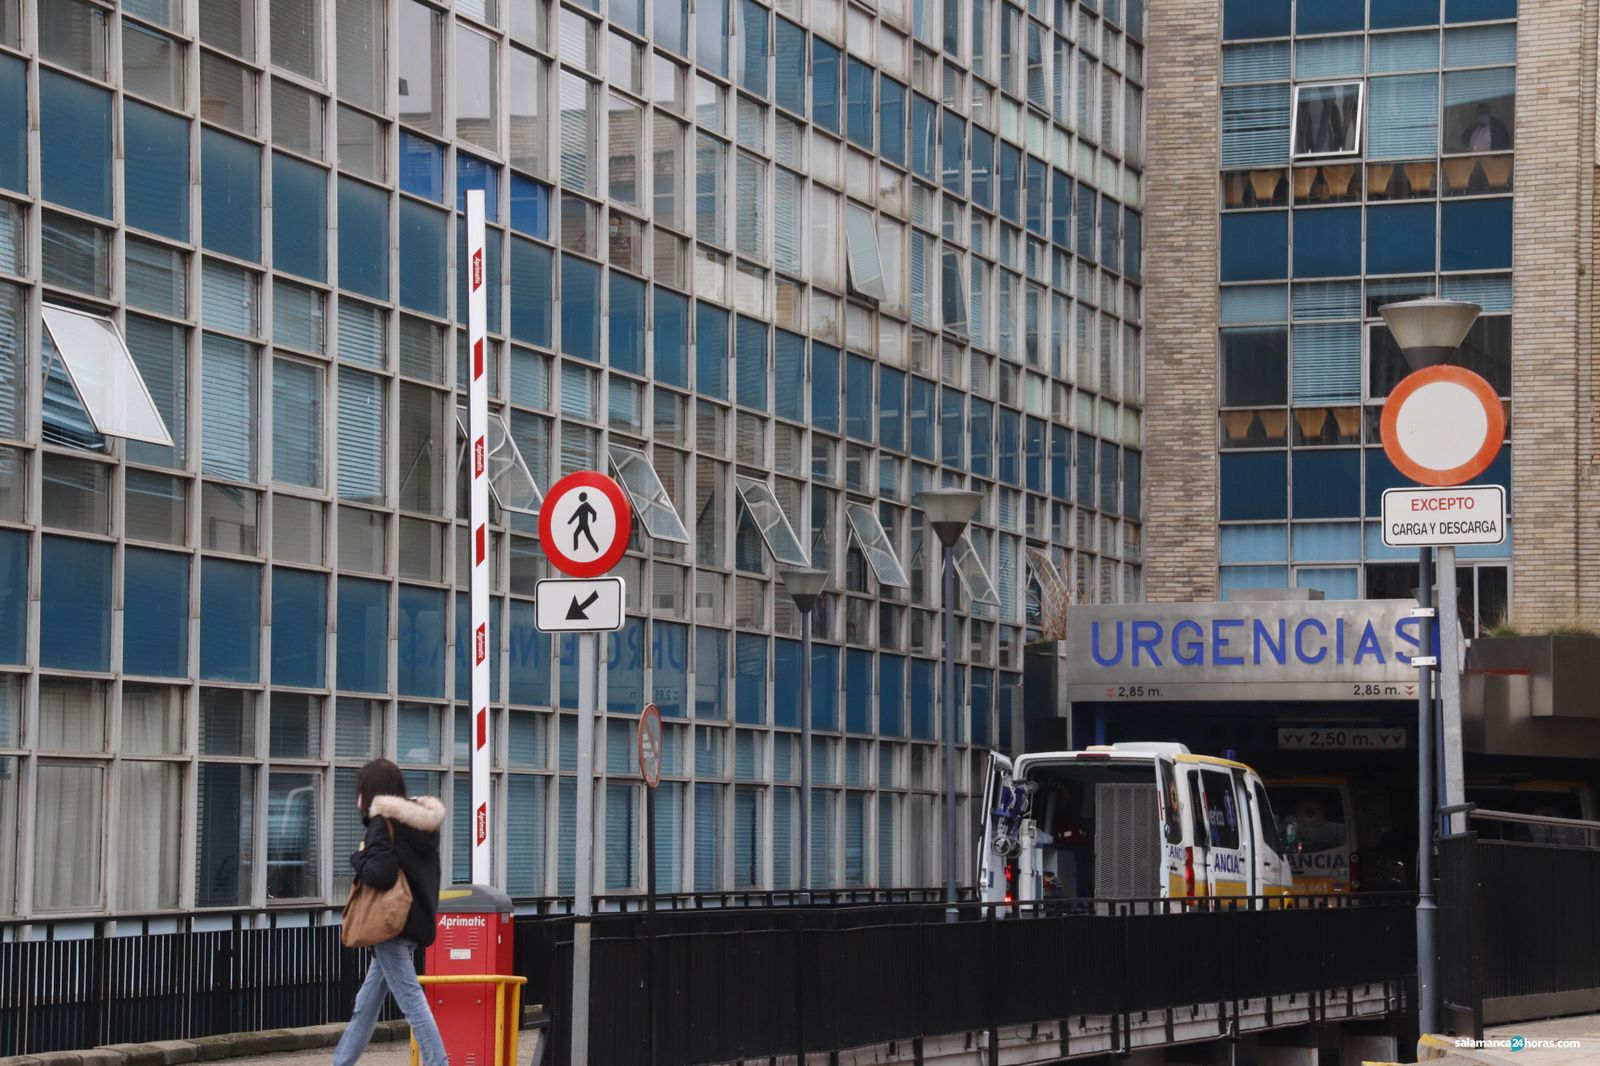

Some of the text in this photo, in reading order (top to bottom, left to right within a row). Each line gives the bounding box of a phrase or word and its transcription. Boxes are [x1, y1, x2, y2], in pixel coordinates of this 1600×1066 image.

[1411, 497, 1475, 511] EXCEPTO
[1392, 520, 1497, 536] CARGA Y DESCARGA
[1091, 617, 1424, 668] URGENCIAS
[1118, 686, 1163, 698] 2,85 m.
[1353, 684, 1401, 697] 2,85 m.
[1309, 731, 1374, 747] 2,50 m.
[438, 914, 486, 929] Aprimatic
